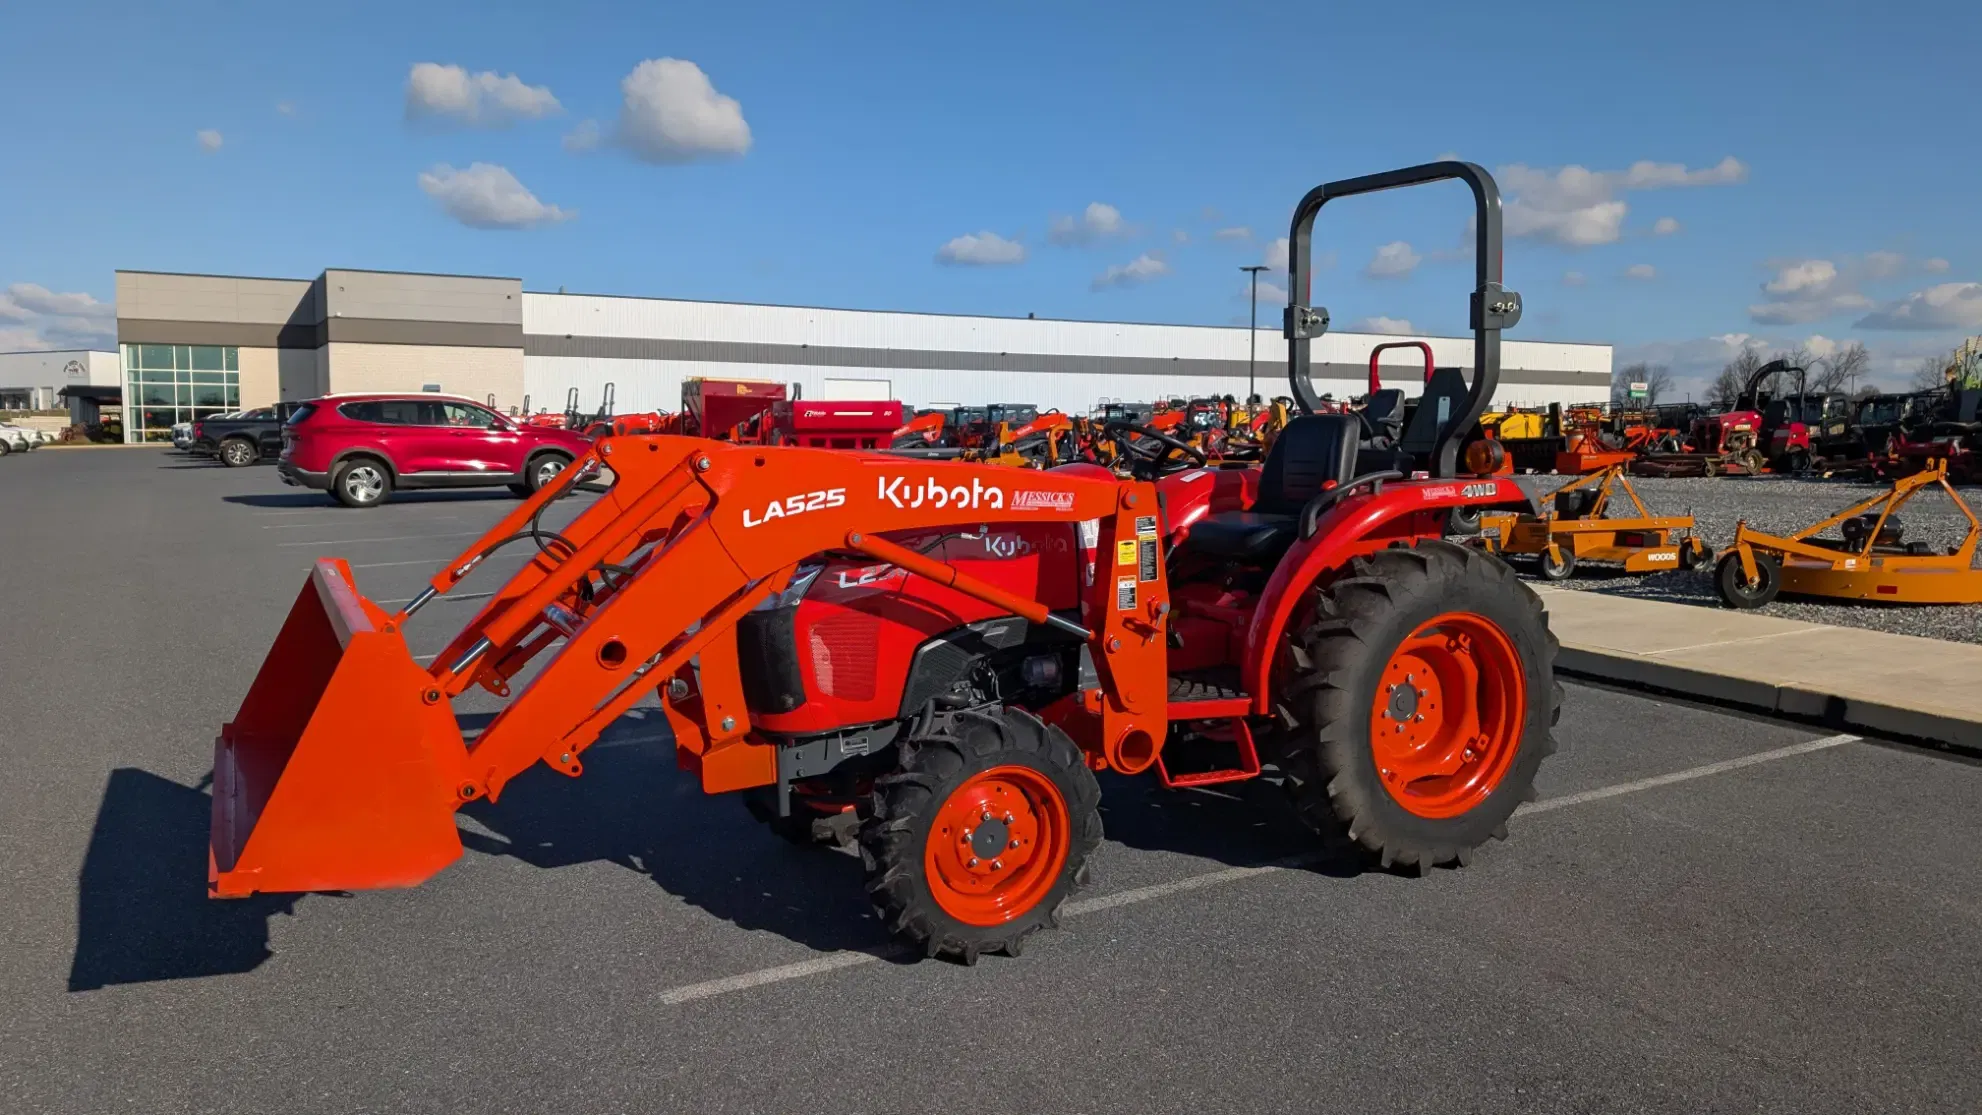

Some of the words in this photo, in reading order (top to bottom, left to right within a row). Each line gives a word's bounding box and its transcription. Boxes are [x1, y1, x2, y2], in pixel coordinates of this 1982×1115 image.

[878, 476, 1004, 509] Kubota
[1010, 490, 1075, 506] MESSICK'S
[1461, 483, 1496, 498] 4WD
[742, 487, 846, 528] LA525
[1647, 552, 1676, 562] WOODS
